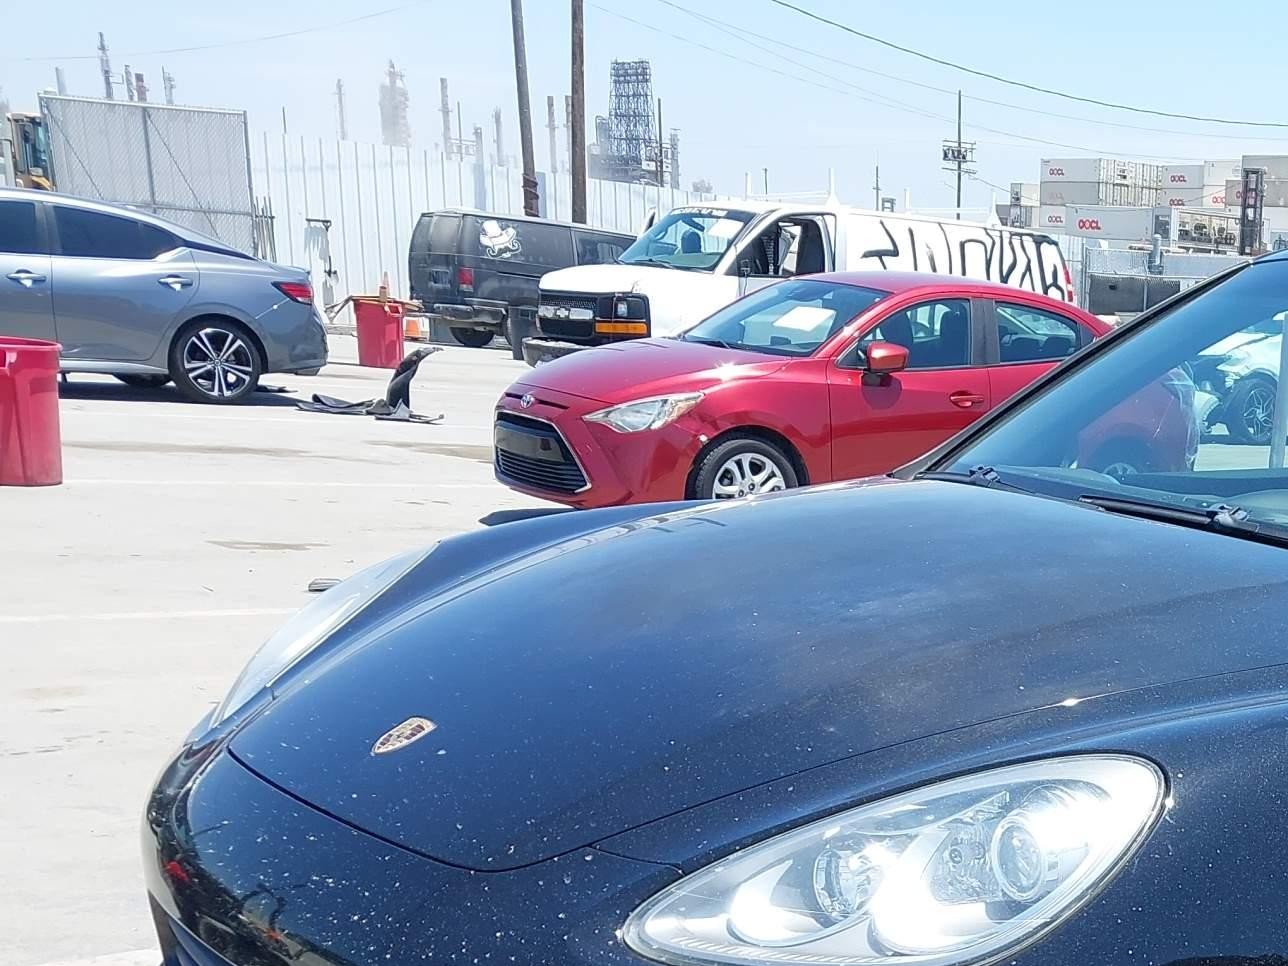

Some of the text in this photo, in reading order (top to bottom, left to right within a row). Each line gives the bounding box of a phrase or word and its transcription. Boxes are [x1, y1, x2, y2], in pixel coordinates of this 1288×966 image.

[1048, 168, 1065, 176] OOCL
[1047, 215, 1064, 223] OOCL
[1078, 219, 1102, 230] OOCL
